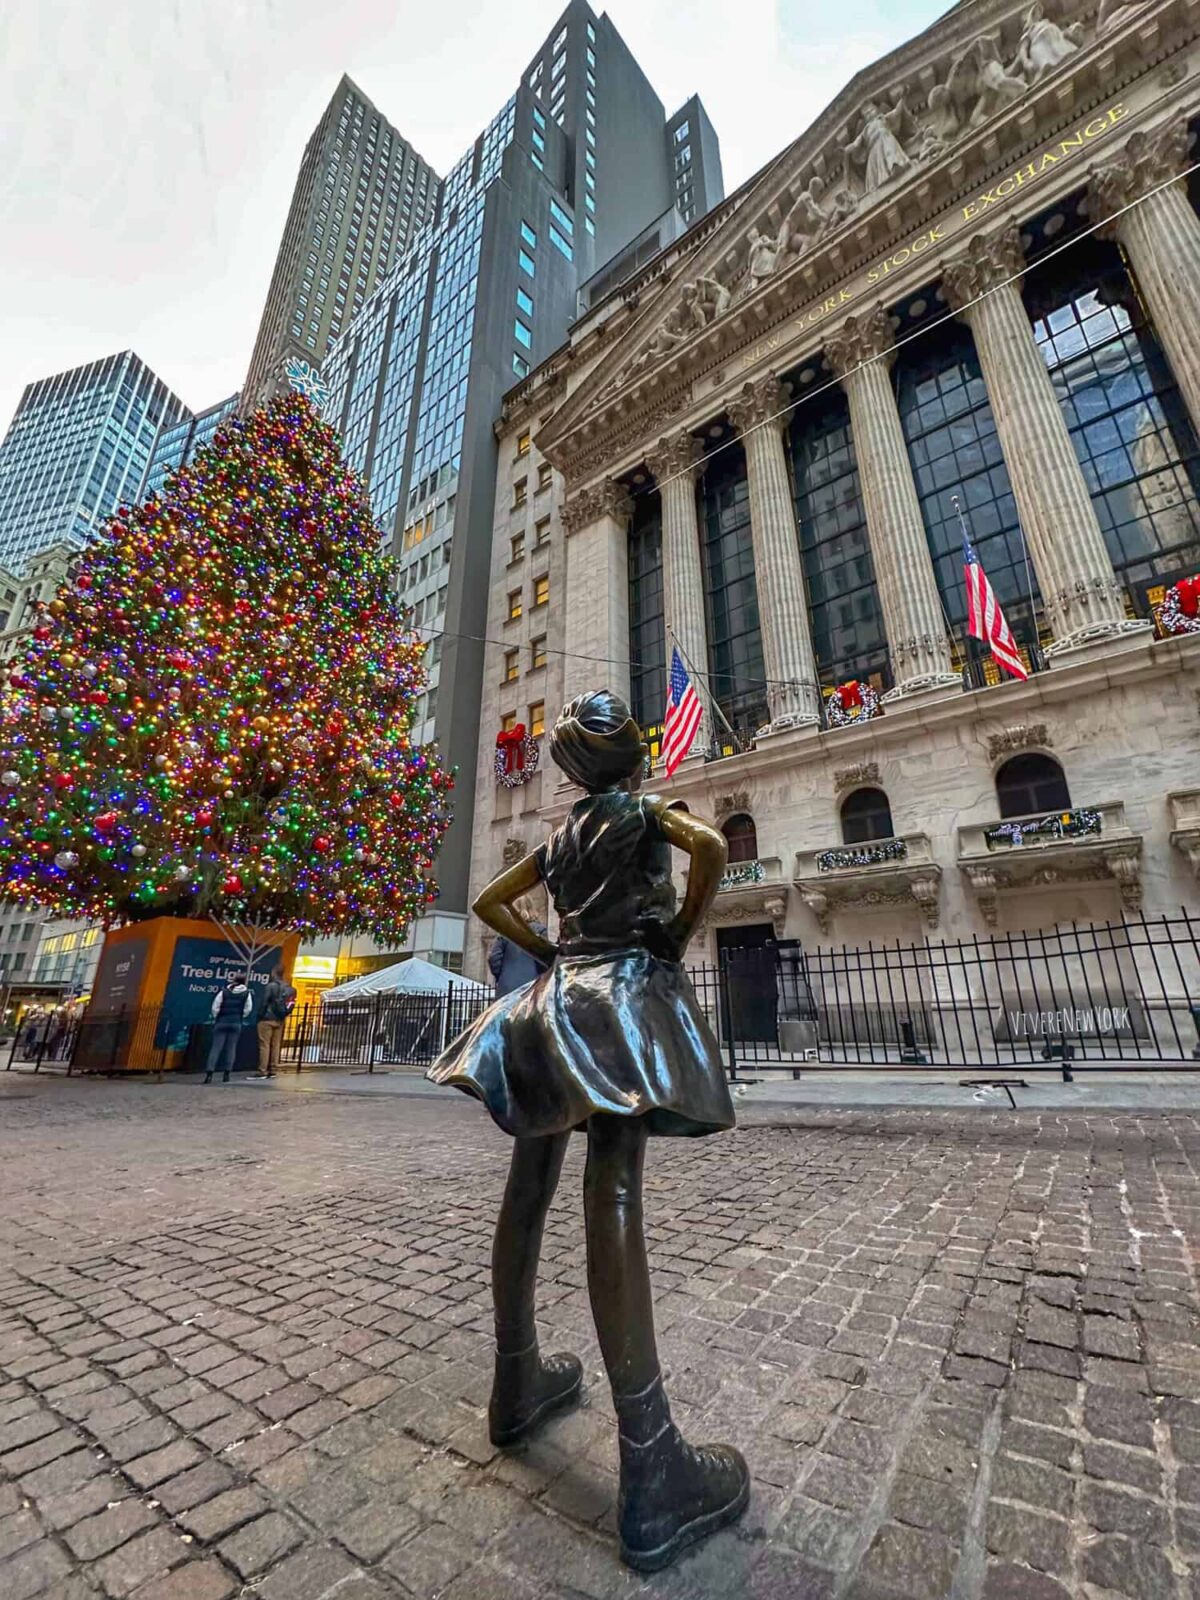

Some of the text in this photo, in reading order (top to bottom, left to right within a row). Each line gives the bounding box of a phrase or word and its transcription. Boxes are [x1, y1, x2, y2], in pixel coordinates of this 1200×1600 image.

[742, 102, 1130, 369] NEW YORK STOCK EXCHANGE
[181, 964, 270, 985] Tree Liging
[207, 985, 219, 993] 30
